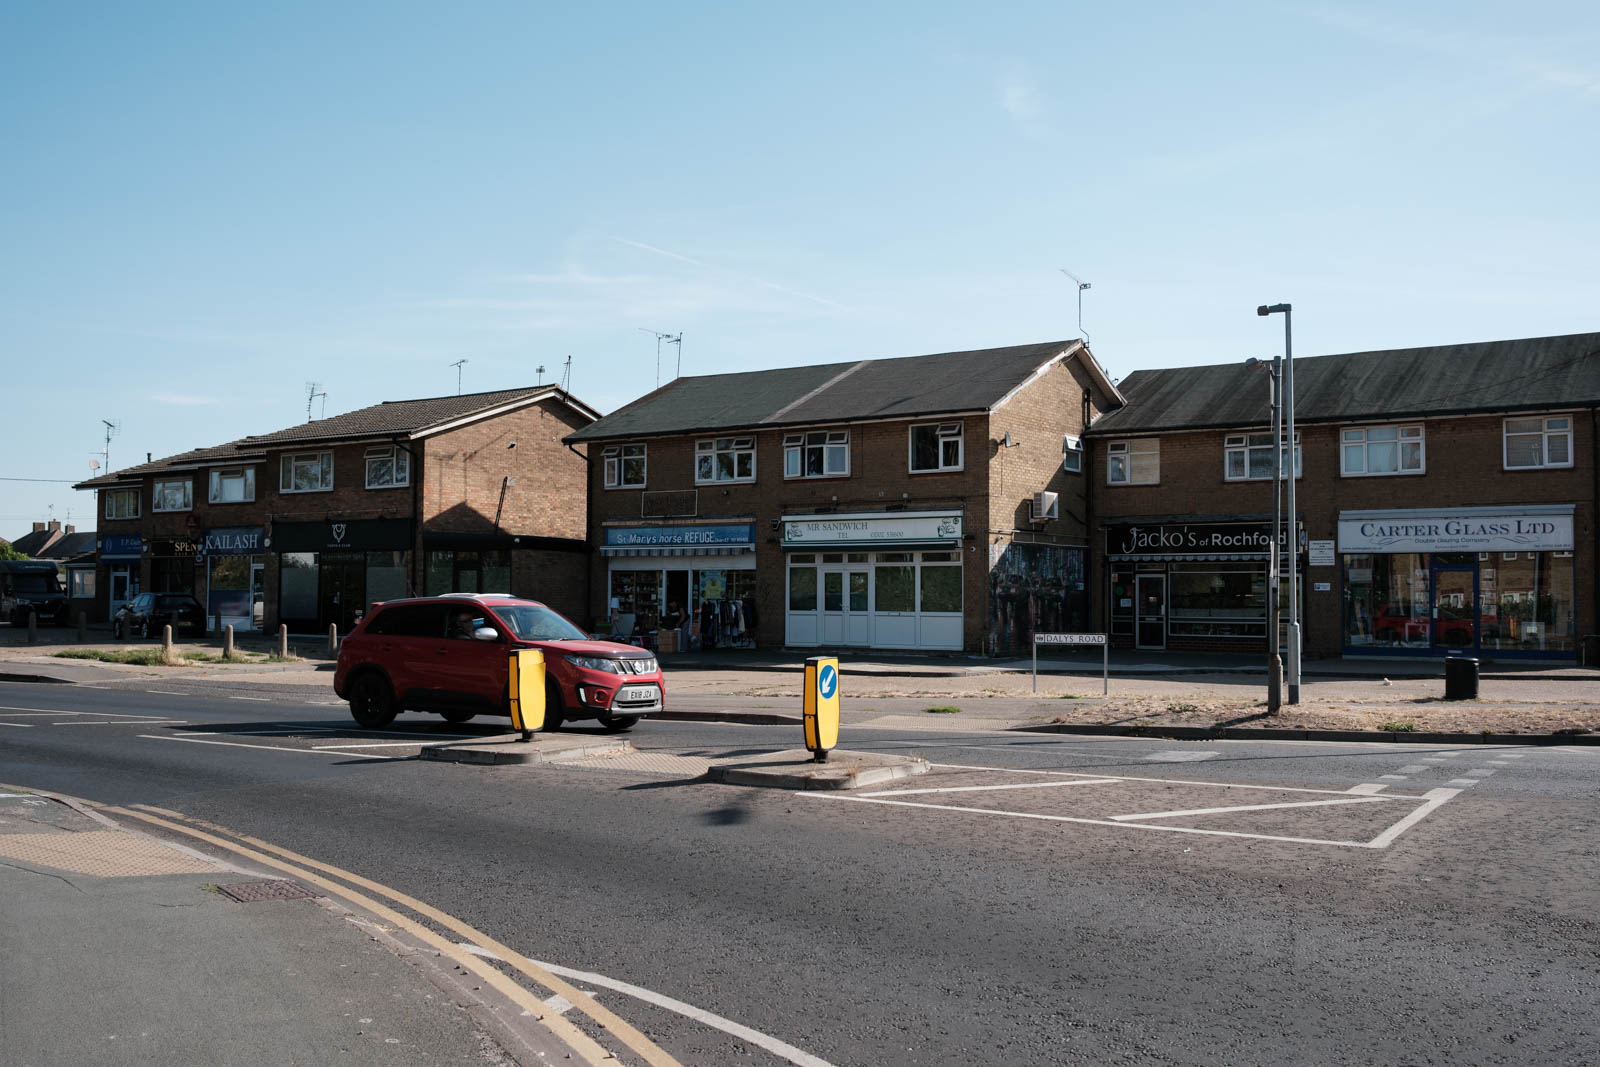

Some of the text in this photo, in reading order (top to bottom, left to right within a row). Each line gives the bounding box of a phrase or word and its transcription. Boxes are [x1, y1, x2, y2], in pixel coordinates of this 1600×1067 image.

[807, 522, 868, 532] MR SANDWICH
[1360, 520, 1555, 537] CARTER GLASS LTD
[205, 534, 258, 549] KAILASH
[617, 534, 626, 544] St
[684, 531, 715, 543] REFUGE
[1121, 526, 1287, 553] Jacko's of Rochfod
[1046, 635, 1104, 643] DALYS ROAD
